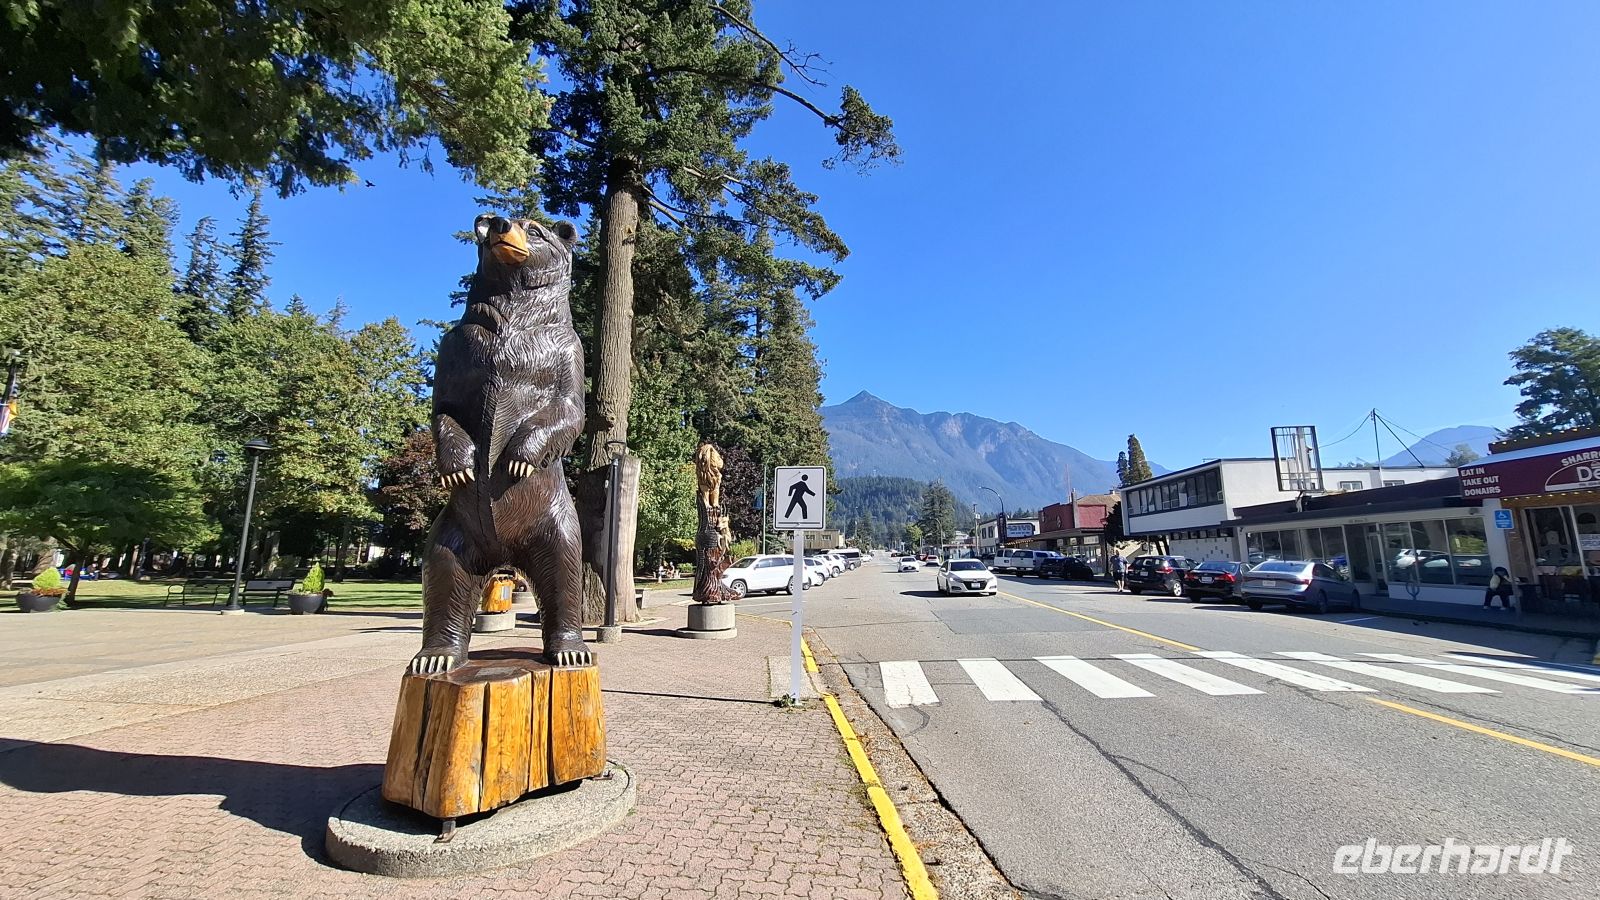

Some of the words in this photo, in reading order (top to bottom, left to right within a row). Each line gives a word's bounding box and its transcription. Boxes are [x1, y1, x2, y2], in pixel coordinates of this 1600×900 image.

[1561, 451, 1600, 466] SHARR
[1460, 469, 1474, 477] EAT
[1462, 478, 1482, 487] TAKE
[1483, 475, 1499, 483] OUT
[1464, 486, 1501, 496] DONAIRS
